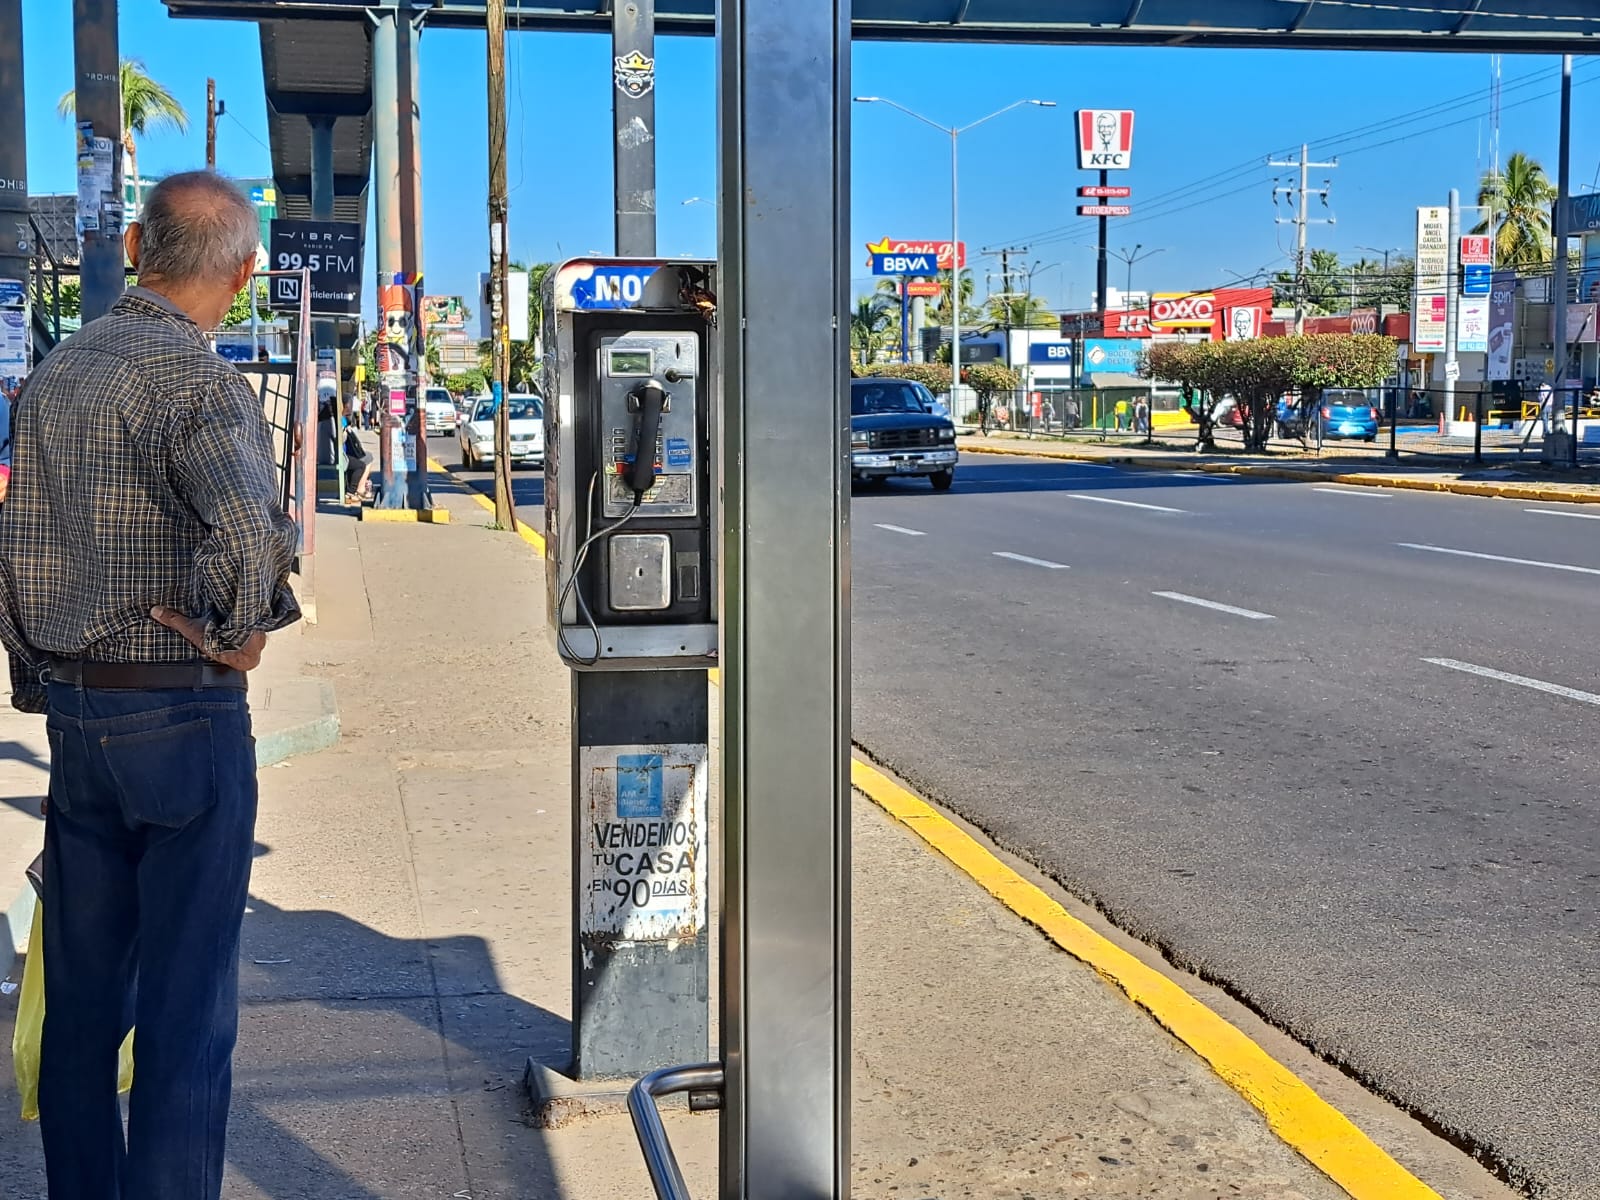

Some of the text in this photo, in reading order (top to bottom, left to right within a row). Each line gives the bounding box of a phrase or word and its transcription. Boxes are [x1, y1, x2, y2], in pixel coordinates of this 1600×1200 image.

[1090, 153, 1123, 166] KFC
[1082, 206, 1130, 215] AUTOEXPRESS
[278, 231, 356, 241] VIBRA
[325, 255, 354, 272] FM
[883, 256, 929, 271] BBVA
[1493, 291, 1511, 306] spin
[1153, 299, 1213, 320] OXXO
[1351, 315, 1376, 335] OXXO
[594, 821, 698, 849] VENDEMOS
[592, 853, 615, 866] TU
[615, 851, 696, 876] CASA
[592, 880, 612, 891] EN
[613, 879, 651, 908] 90
[652, 878, 688, 895] DÍAS
